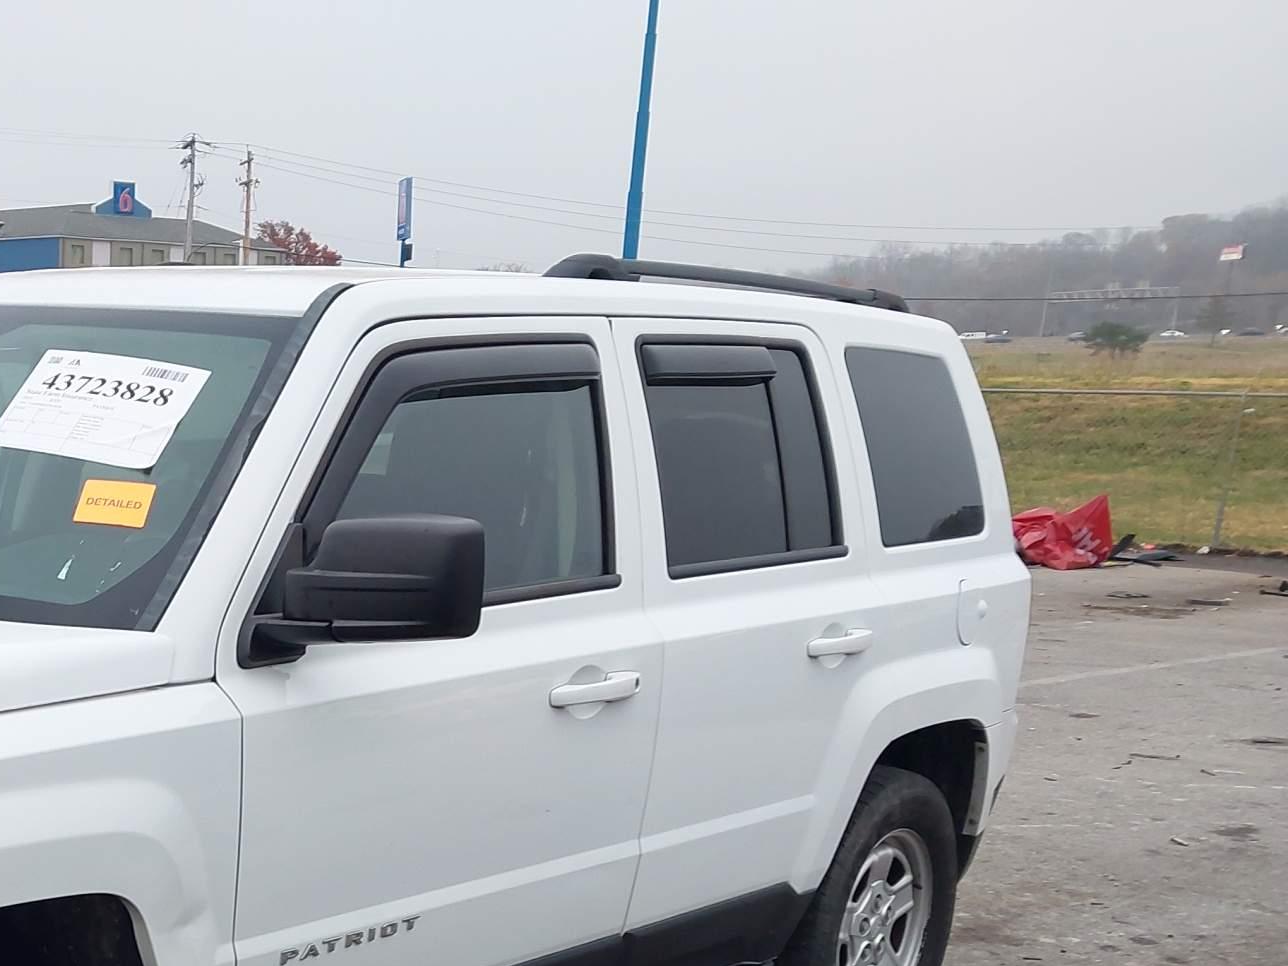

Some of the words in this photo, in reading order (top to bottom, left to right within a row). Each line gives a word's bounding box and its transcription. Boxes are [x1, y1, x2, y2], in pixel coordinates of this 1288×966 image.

[119, 187, 132, 212] 6
[42, 372, 174, 407] 43723828
[85, 497, 143, 509] DETAILED
[279, 915, 421, 966] PATRIOT
